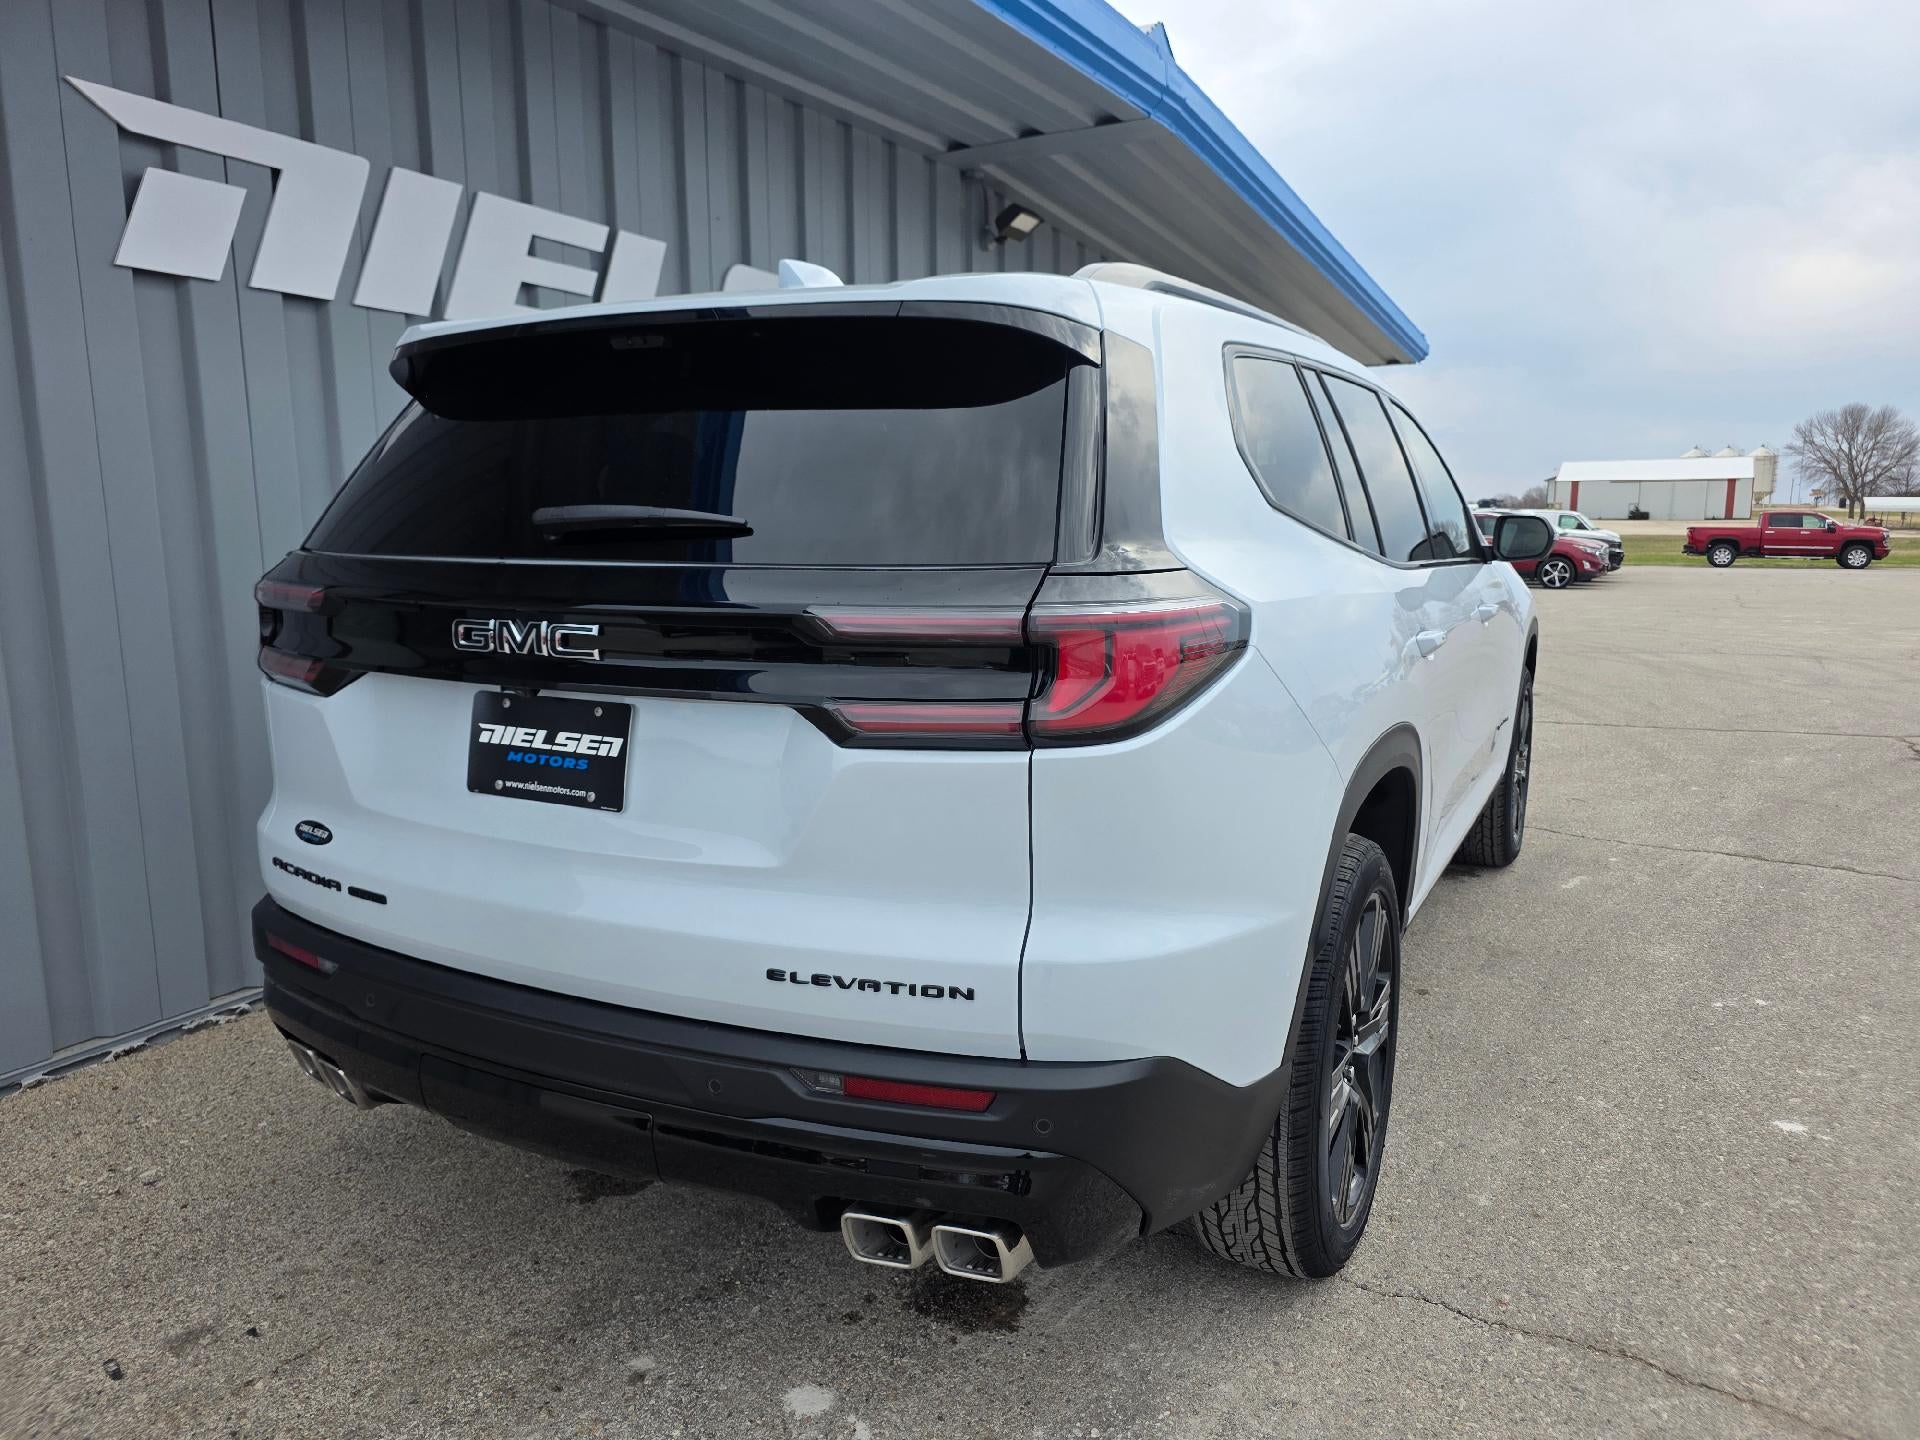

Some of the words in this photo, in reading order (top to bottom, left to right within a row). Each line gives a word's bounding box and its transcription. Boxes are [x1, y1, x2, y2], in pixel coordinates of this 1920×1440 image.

[452, 618, 600, 661] GMC
[478, 722, 624, 758] NIELSEN
[507, 751, 589, 770] MOTORS
[505, 780, 587, 798] www.nielsenmotors.com
[272, 856, 342, 892] ACADIA
[766, 967, 975, 1001] ELEVATION
